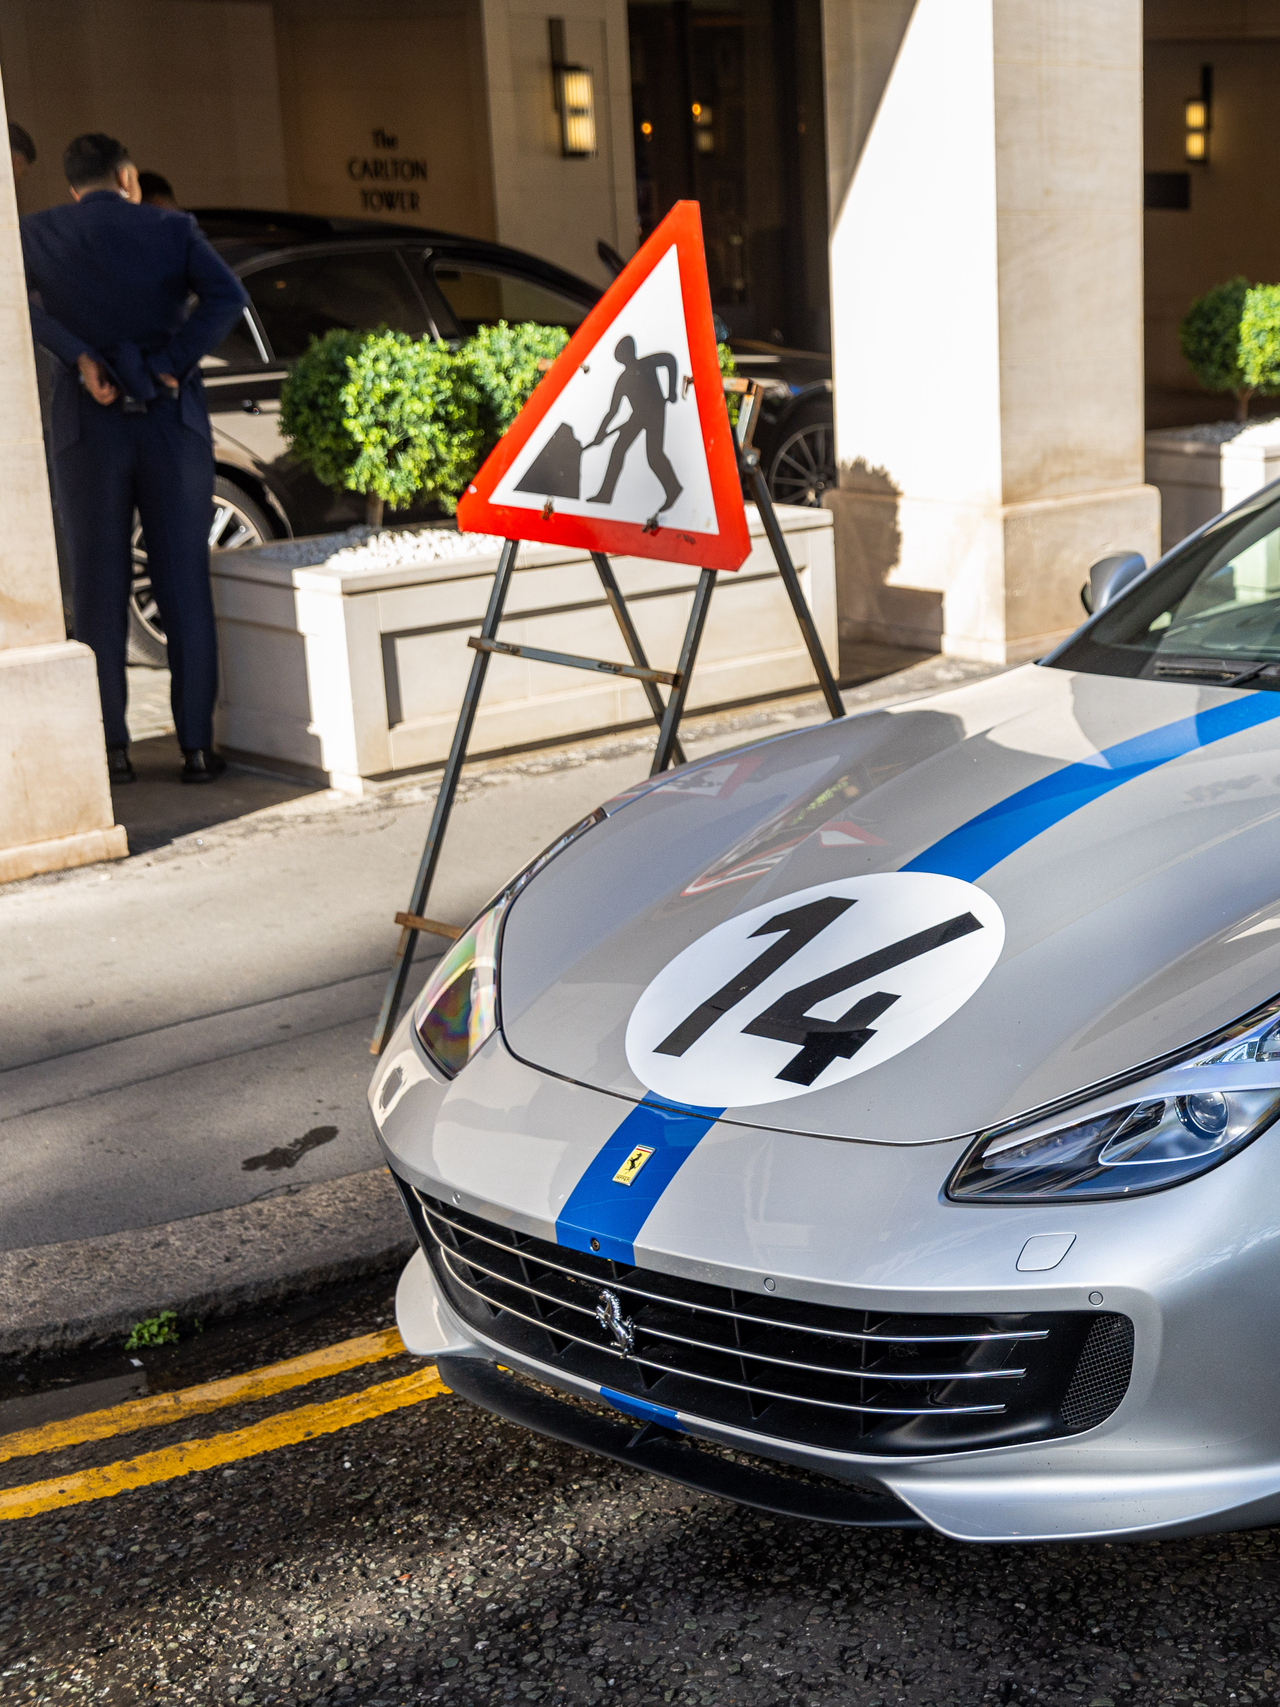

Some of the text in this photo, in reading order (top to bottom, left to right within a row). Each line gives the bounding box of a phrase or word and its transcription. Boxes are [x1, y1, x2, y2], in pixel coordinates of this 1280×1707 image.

[371, 128, 398, 149] The
[347, 157, 428, 182] CARLTON
[360, 189, 420, 212] TOWER
[652, 896, 985, 1086] 14
